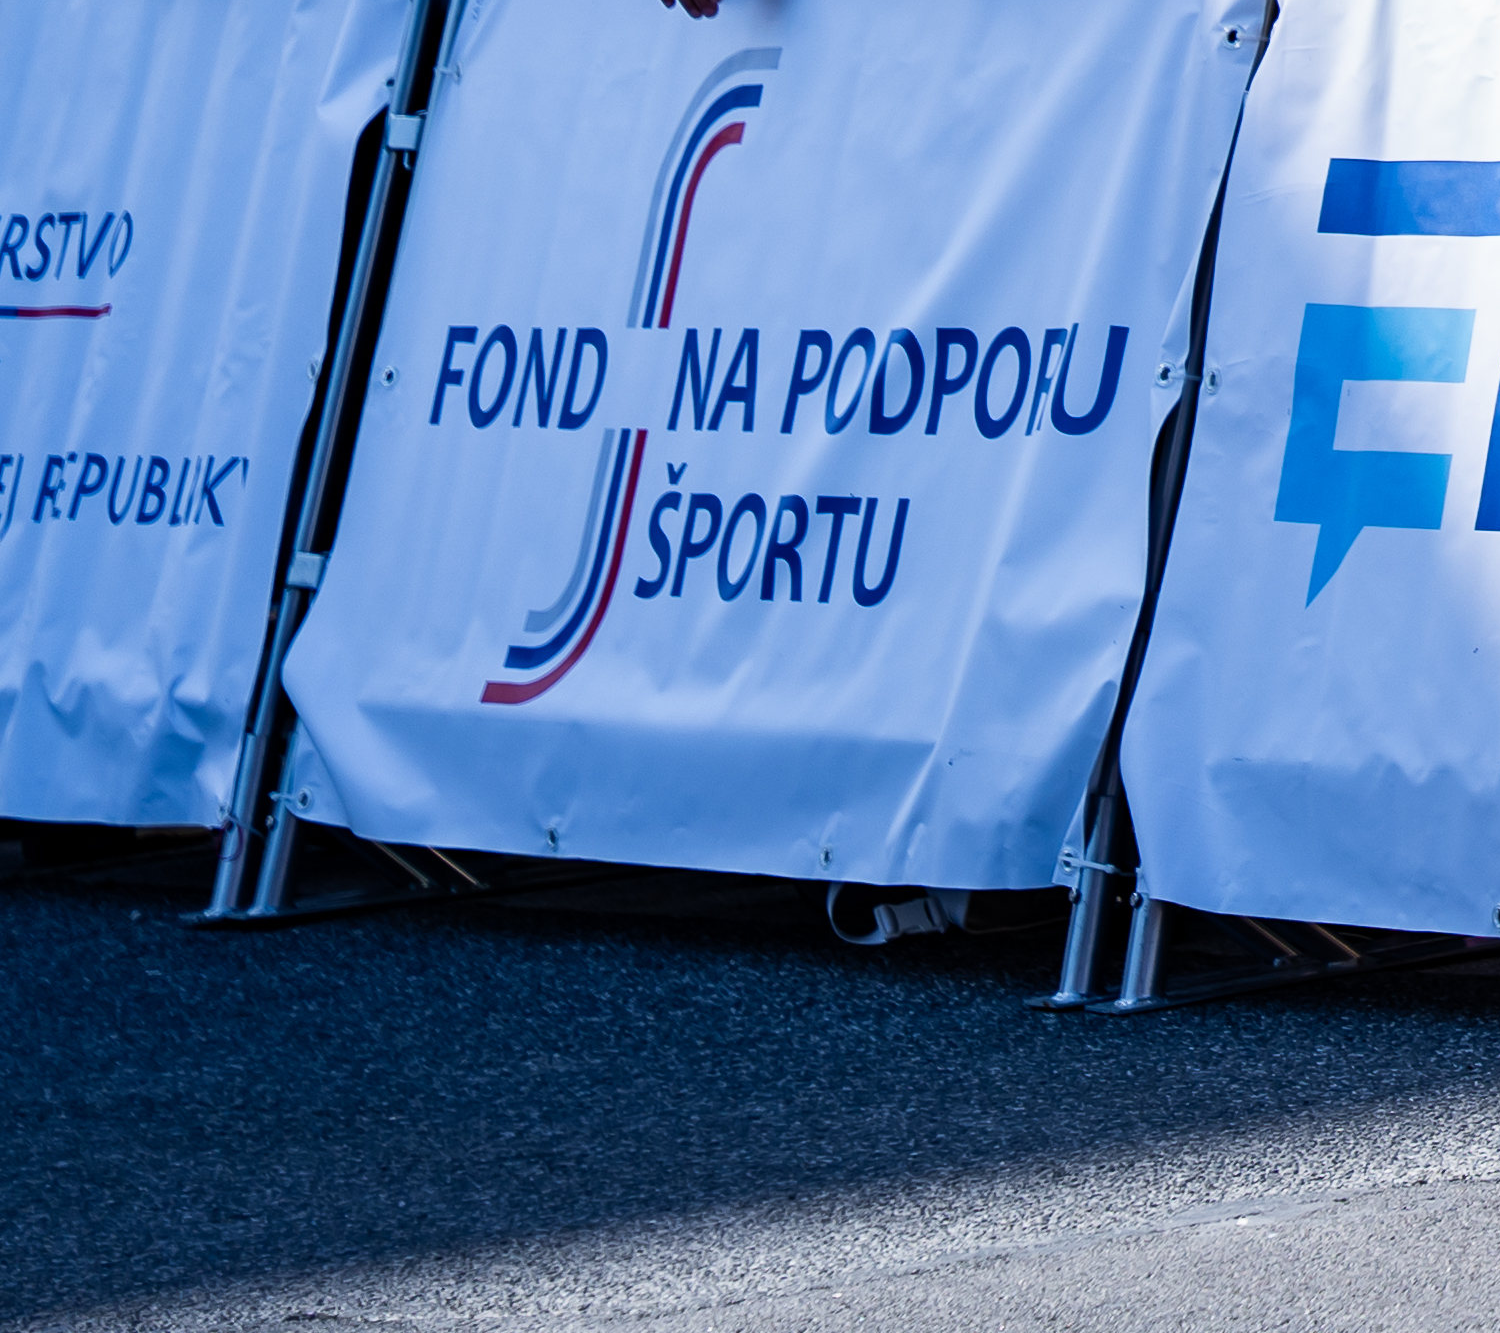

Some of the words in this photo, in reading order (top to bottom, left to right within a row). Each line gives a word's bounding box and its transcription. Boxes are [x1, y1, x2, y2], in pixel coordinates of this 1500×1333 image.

[428, 324, 609, 430] FOND
[666, 327, 760, 432] NA
[633, 462, 911, 608] ŠPORTU
